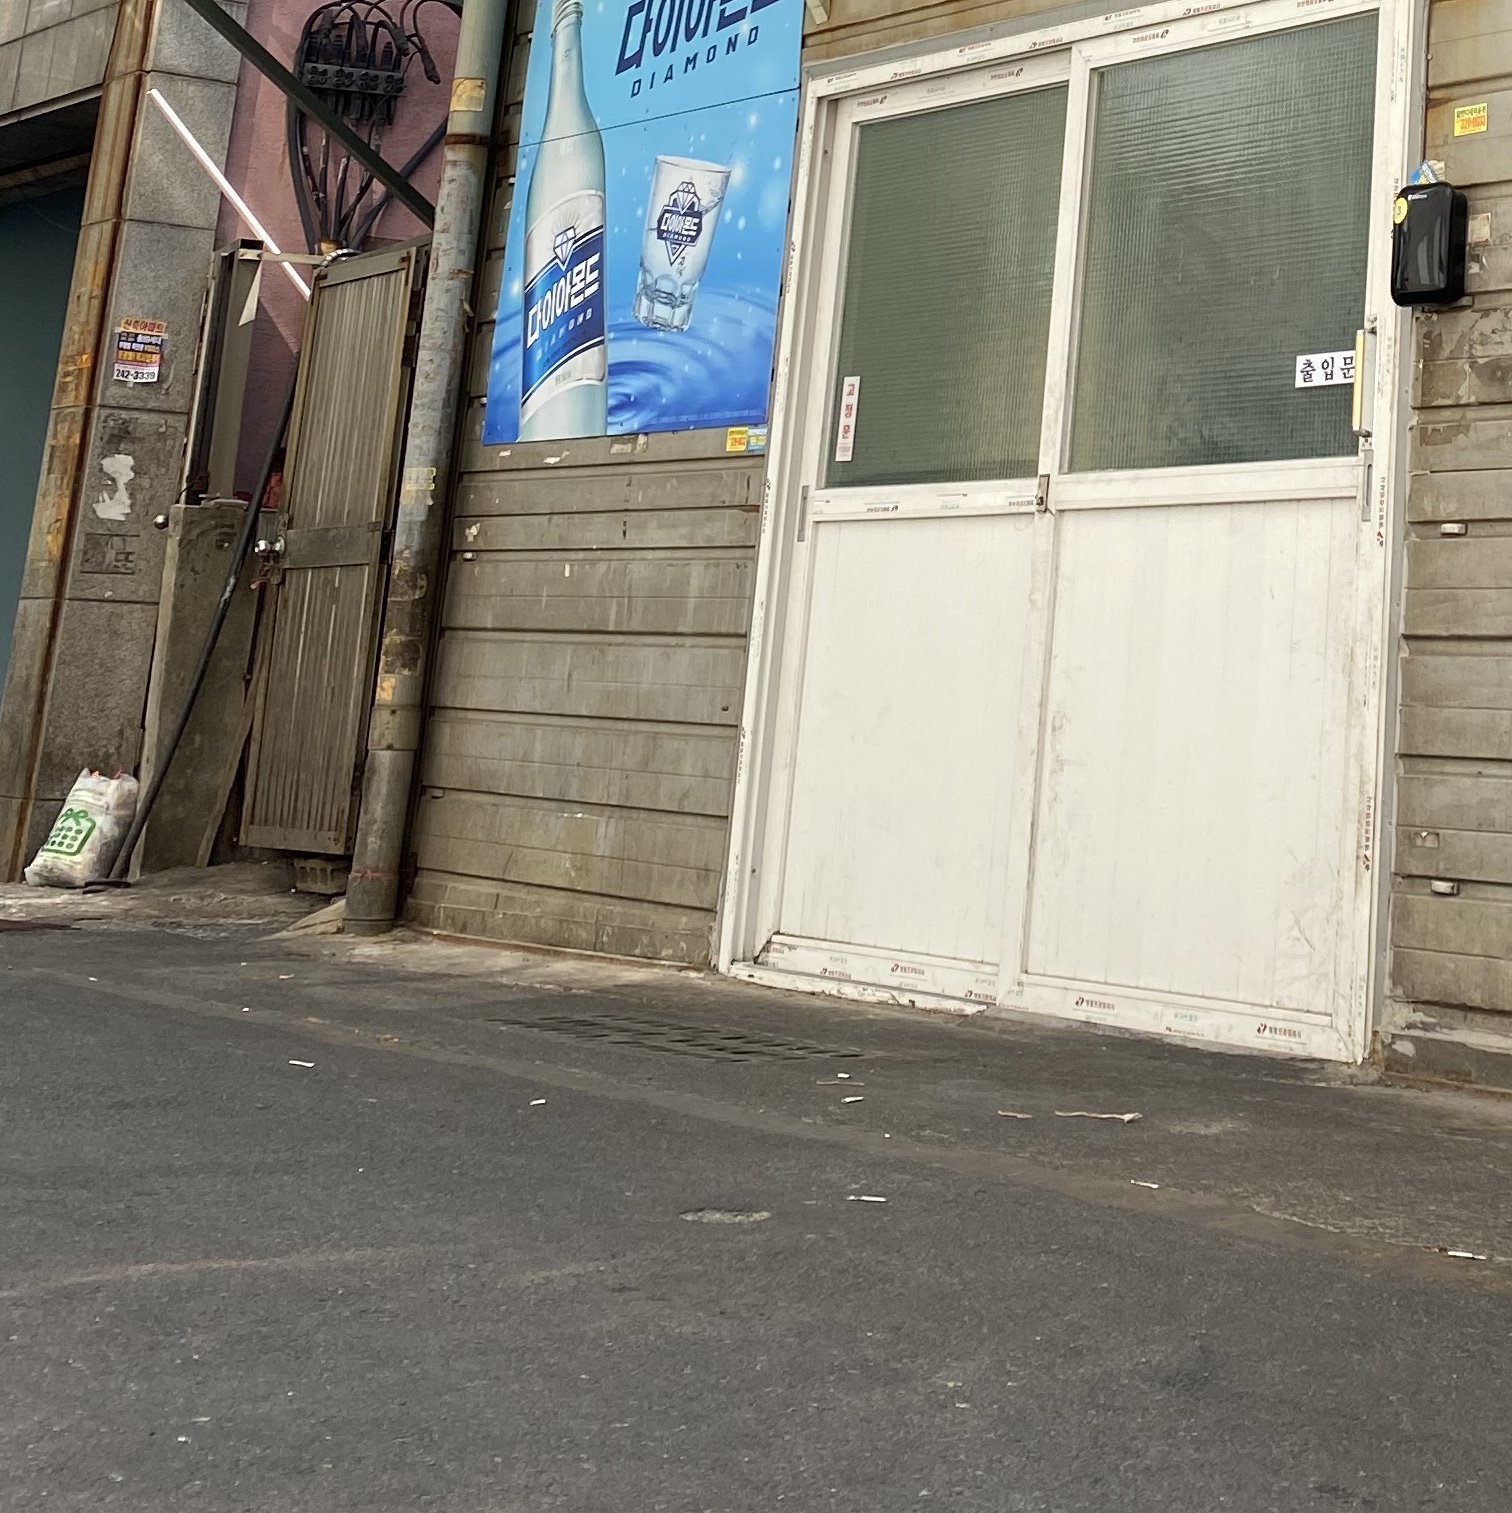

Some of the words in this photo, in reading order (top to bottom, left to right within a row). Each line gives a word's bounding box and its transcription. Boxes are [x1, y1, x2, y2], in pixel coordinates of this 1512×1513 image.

[630, 25, 760, 99] DIAMOND
[526, 252, 600, 350] 다이아몬드
[1299, 355, 1356, 383] 출입문
